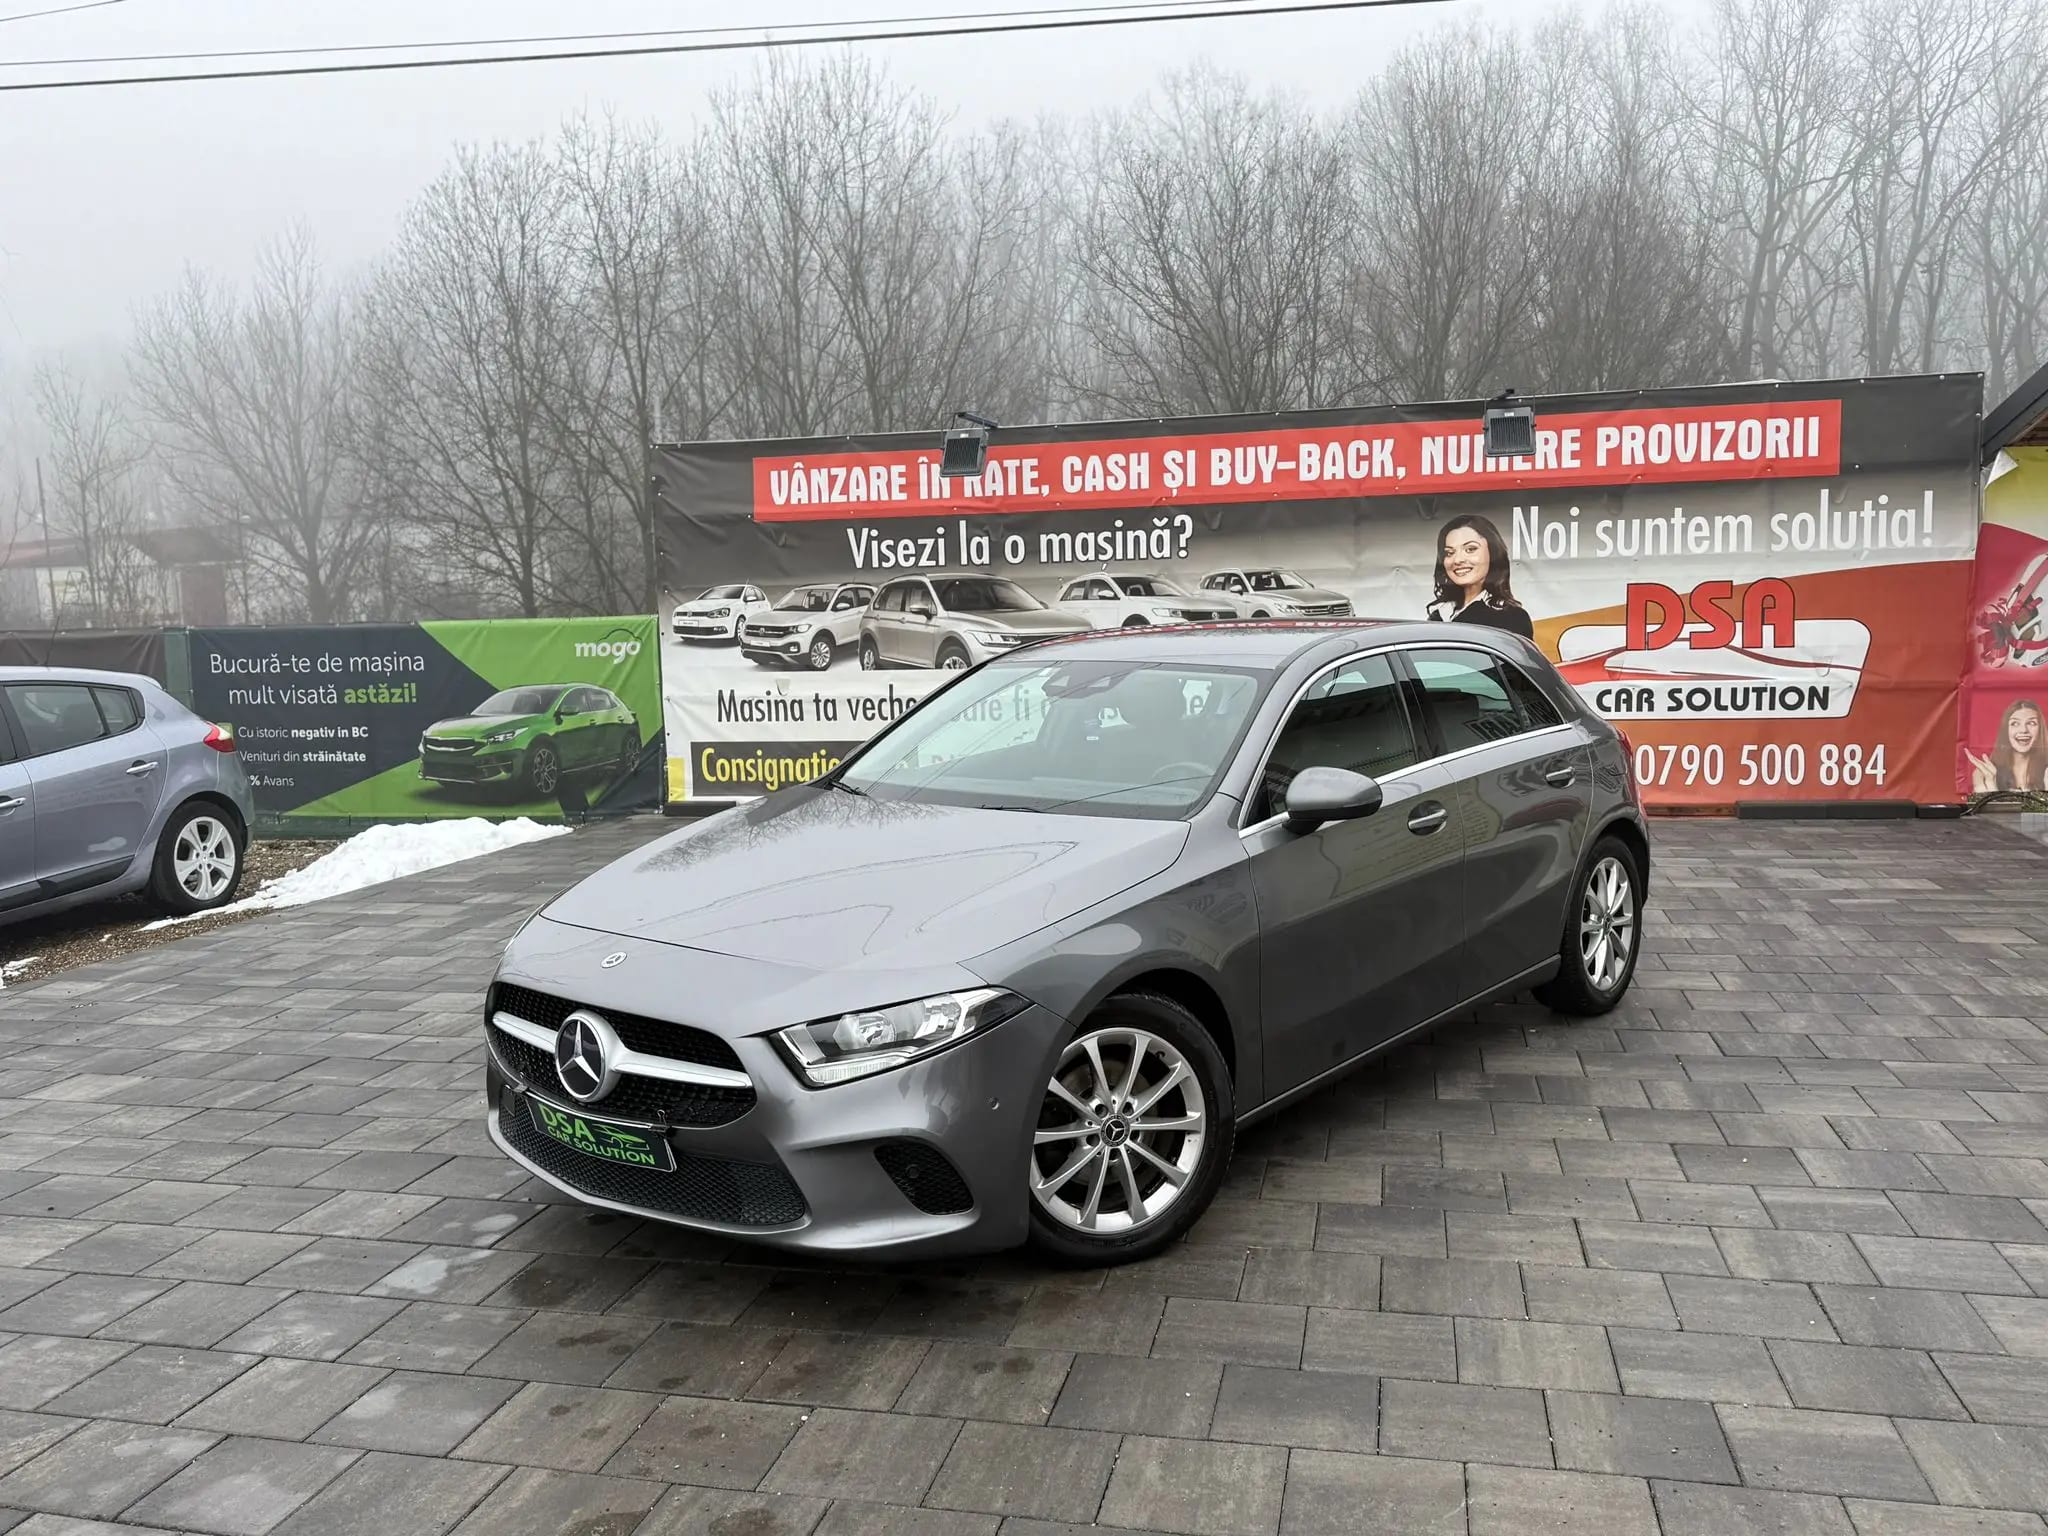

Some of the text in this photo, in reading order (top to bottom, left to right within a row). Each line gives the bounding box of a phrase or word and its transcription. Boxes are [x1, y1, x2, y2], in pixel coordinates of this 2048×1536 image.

[770, 461, 908, 506] VÂNZARE
[917, 456, 951, 500] ÎN
[1062, 452, 1150, 492] CASH
[1162, 449, 1196, 497] ȘI
[1209, 436, 1406, 487] BUY-BACK,
[1596, 416, 1820, 467] PROVIZORII
[1512, 488, 1934, 561] Noi suntem soluția!
[846, 513, 1194, 571] Visezi la o mașină?
[1626, 577, 1796, 651] DSA
[210, 651, 425, 677] Bucură-te de mașina
[574, 640, 641, 665] mogo
[228, 682, 417, 705] mult visată astăzi!
[813, 692, 838, 722] ta
[1595, 685, 1830, 713] CAR SOLUTION
[238, 726, 254, 738] Cu
[256, 726, 289, 738] istoric
[291, 727, 335, 740] negativ
[352, 726, 369, 738] BC
[239, 750, 367, 762] Venituri din străinătate
[1634, 744, 1887, 786] 0790 500 884
[263, 775, 295, 787] Avans
[538, 1103, 596, 1142] DSA
[547, 1126, 656, 1165] CAR SOLUTION
